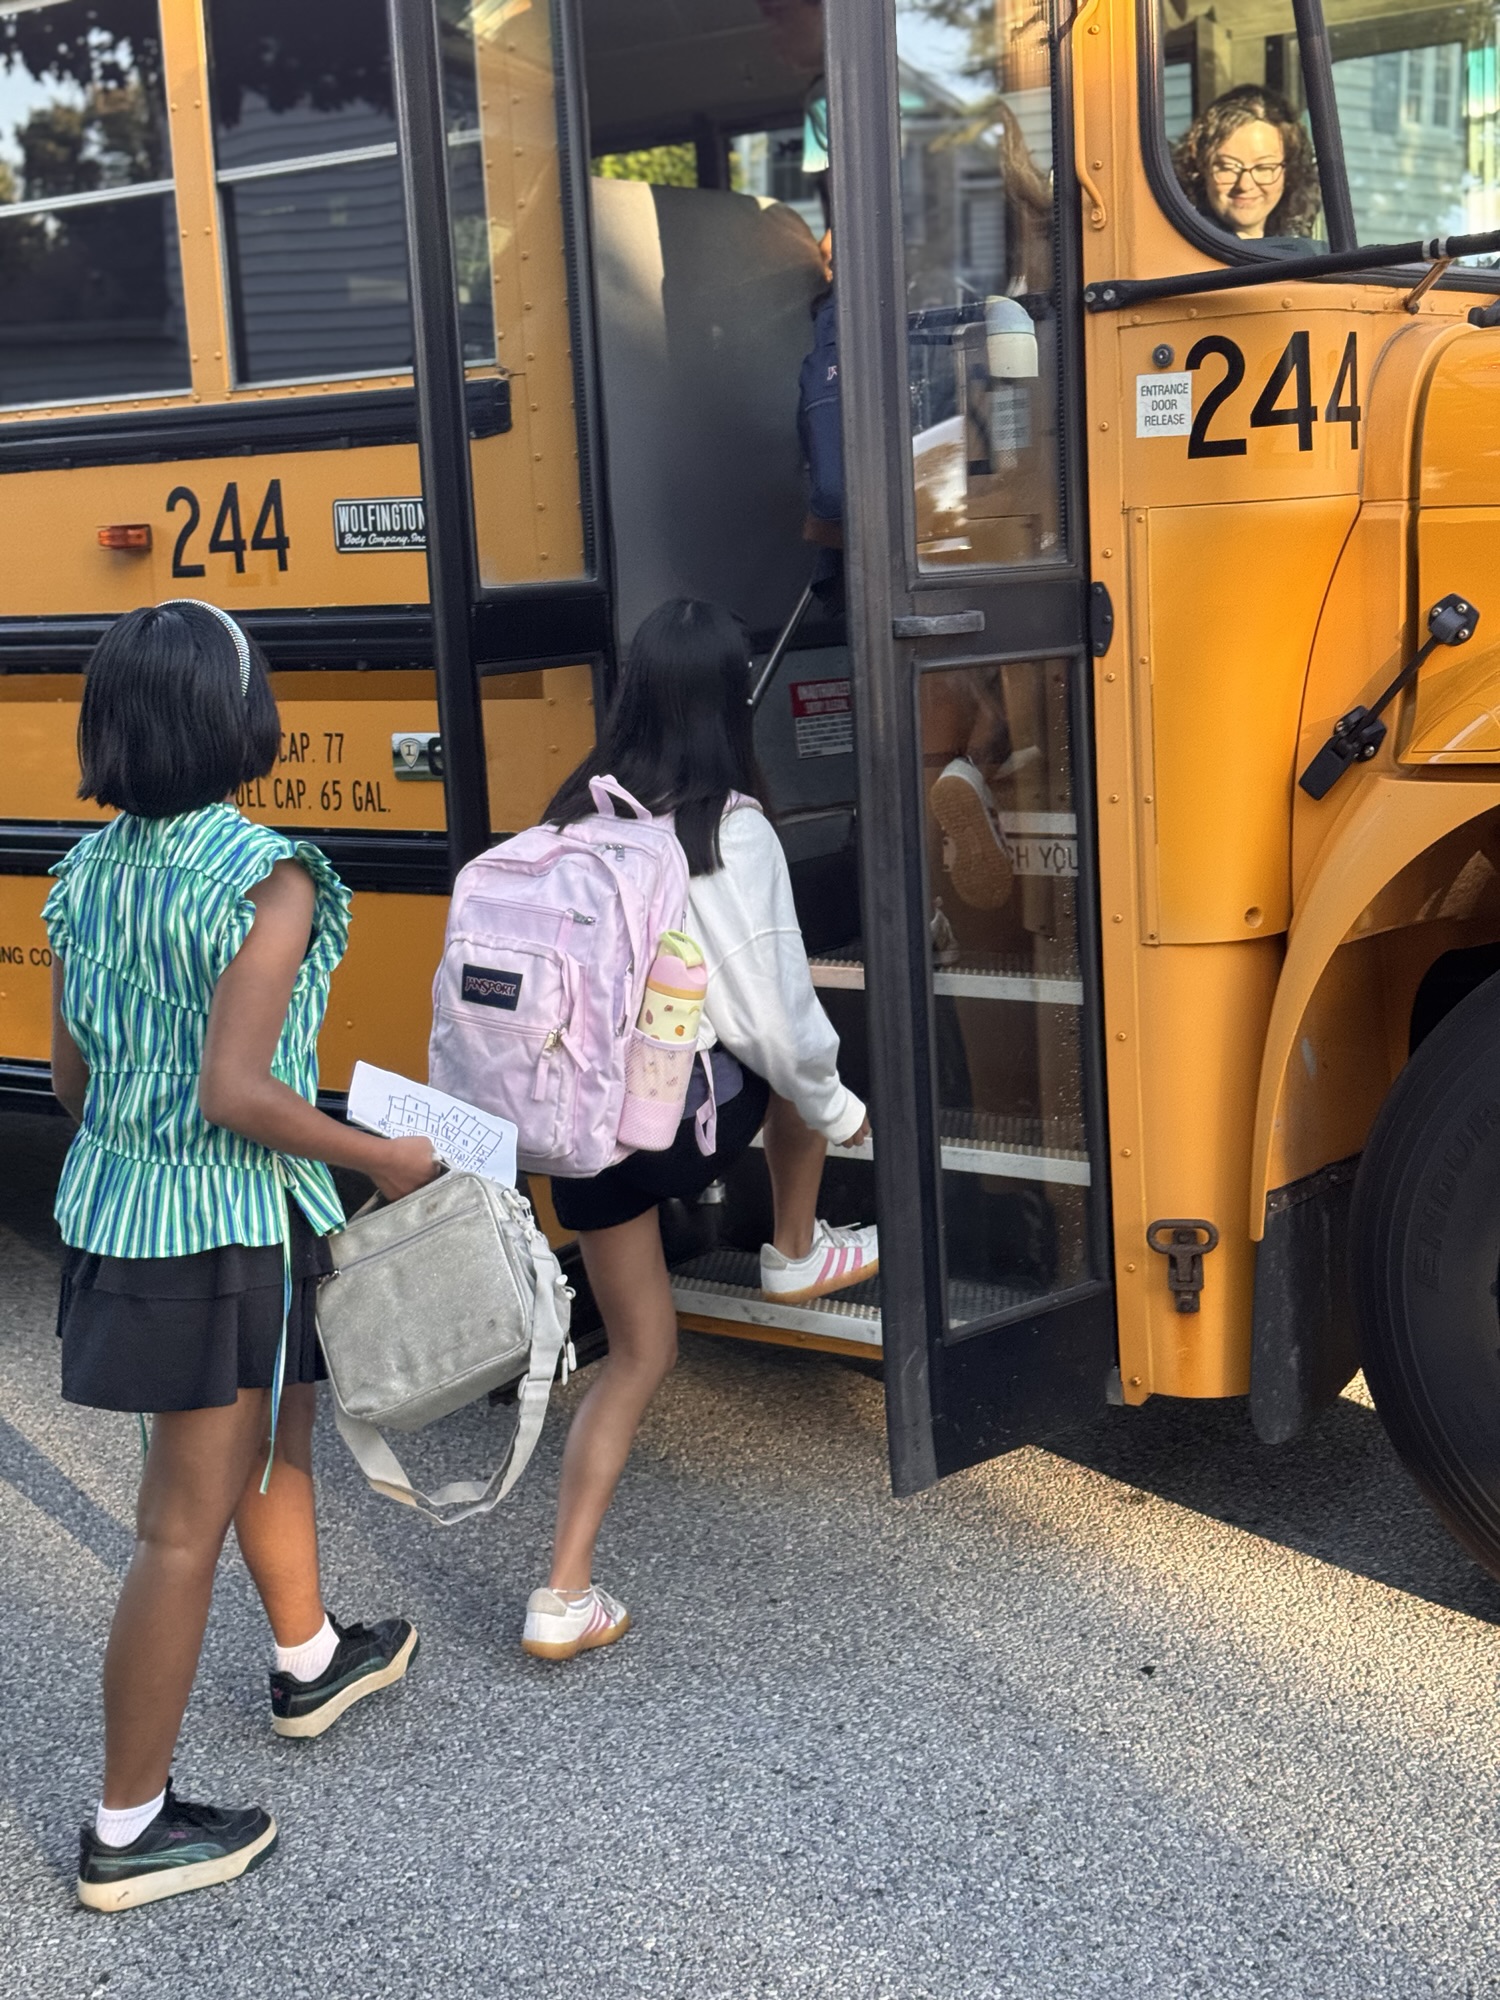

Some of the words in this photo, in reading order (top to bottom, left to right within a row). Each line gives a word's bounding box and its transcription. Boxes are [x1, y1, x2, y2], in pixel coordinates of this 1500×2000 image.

[1140, 383, 1189, 397] ENTRANCE
[1185, 330, 1361, 460] 244
[1151, 399, 1178, 411] DOOR
[1144, 413, 1186, 427] RELEASE
[165, 479, 290, 579] 244
[338, 503, 426, 533] WOLFINGTON
[343, 533, 366, 547] Body
[279, 732, 316, 764] CAP.
[323, 733, 344, 764] 77
[235, 777, 266, 808] UEL
[273, 778, 312, 810] CAP.
[320, 780, 342, 811] 65
[352, 780, 391, 813] GAL.
[1038, 845, 1079, 870] YOU
[0, 946, 24, 965] NG
[464, 976, 517, 997] JANSPORT
